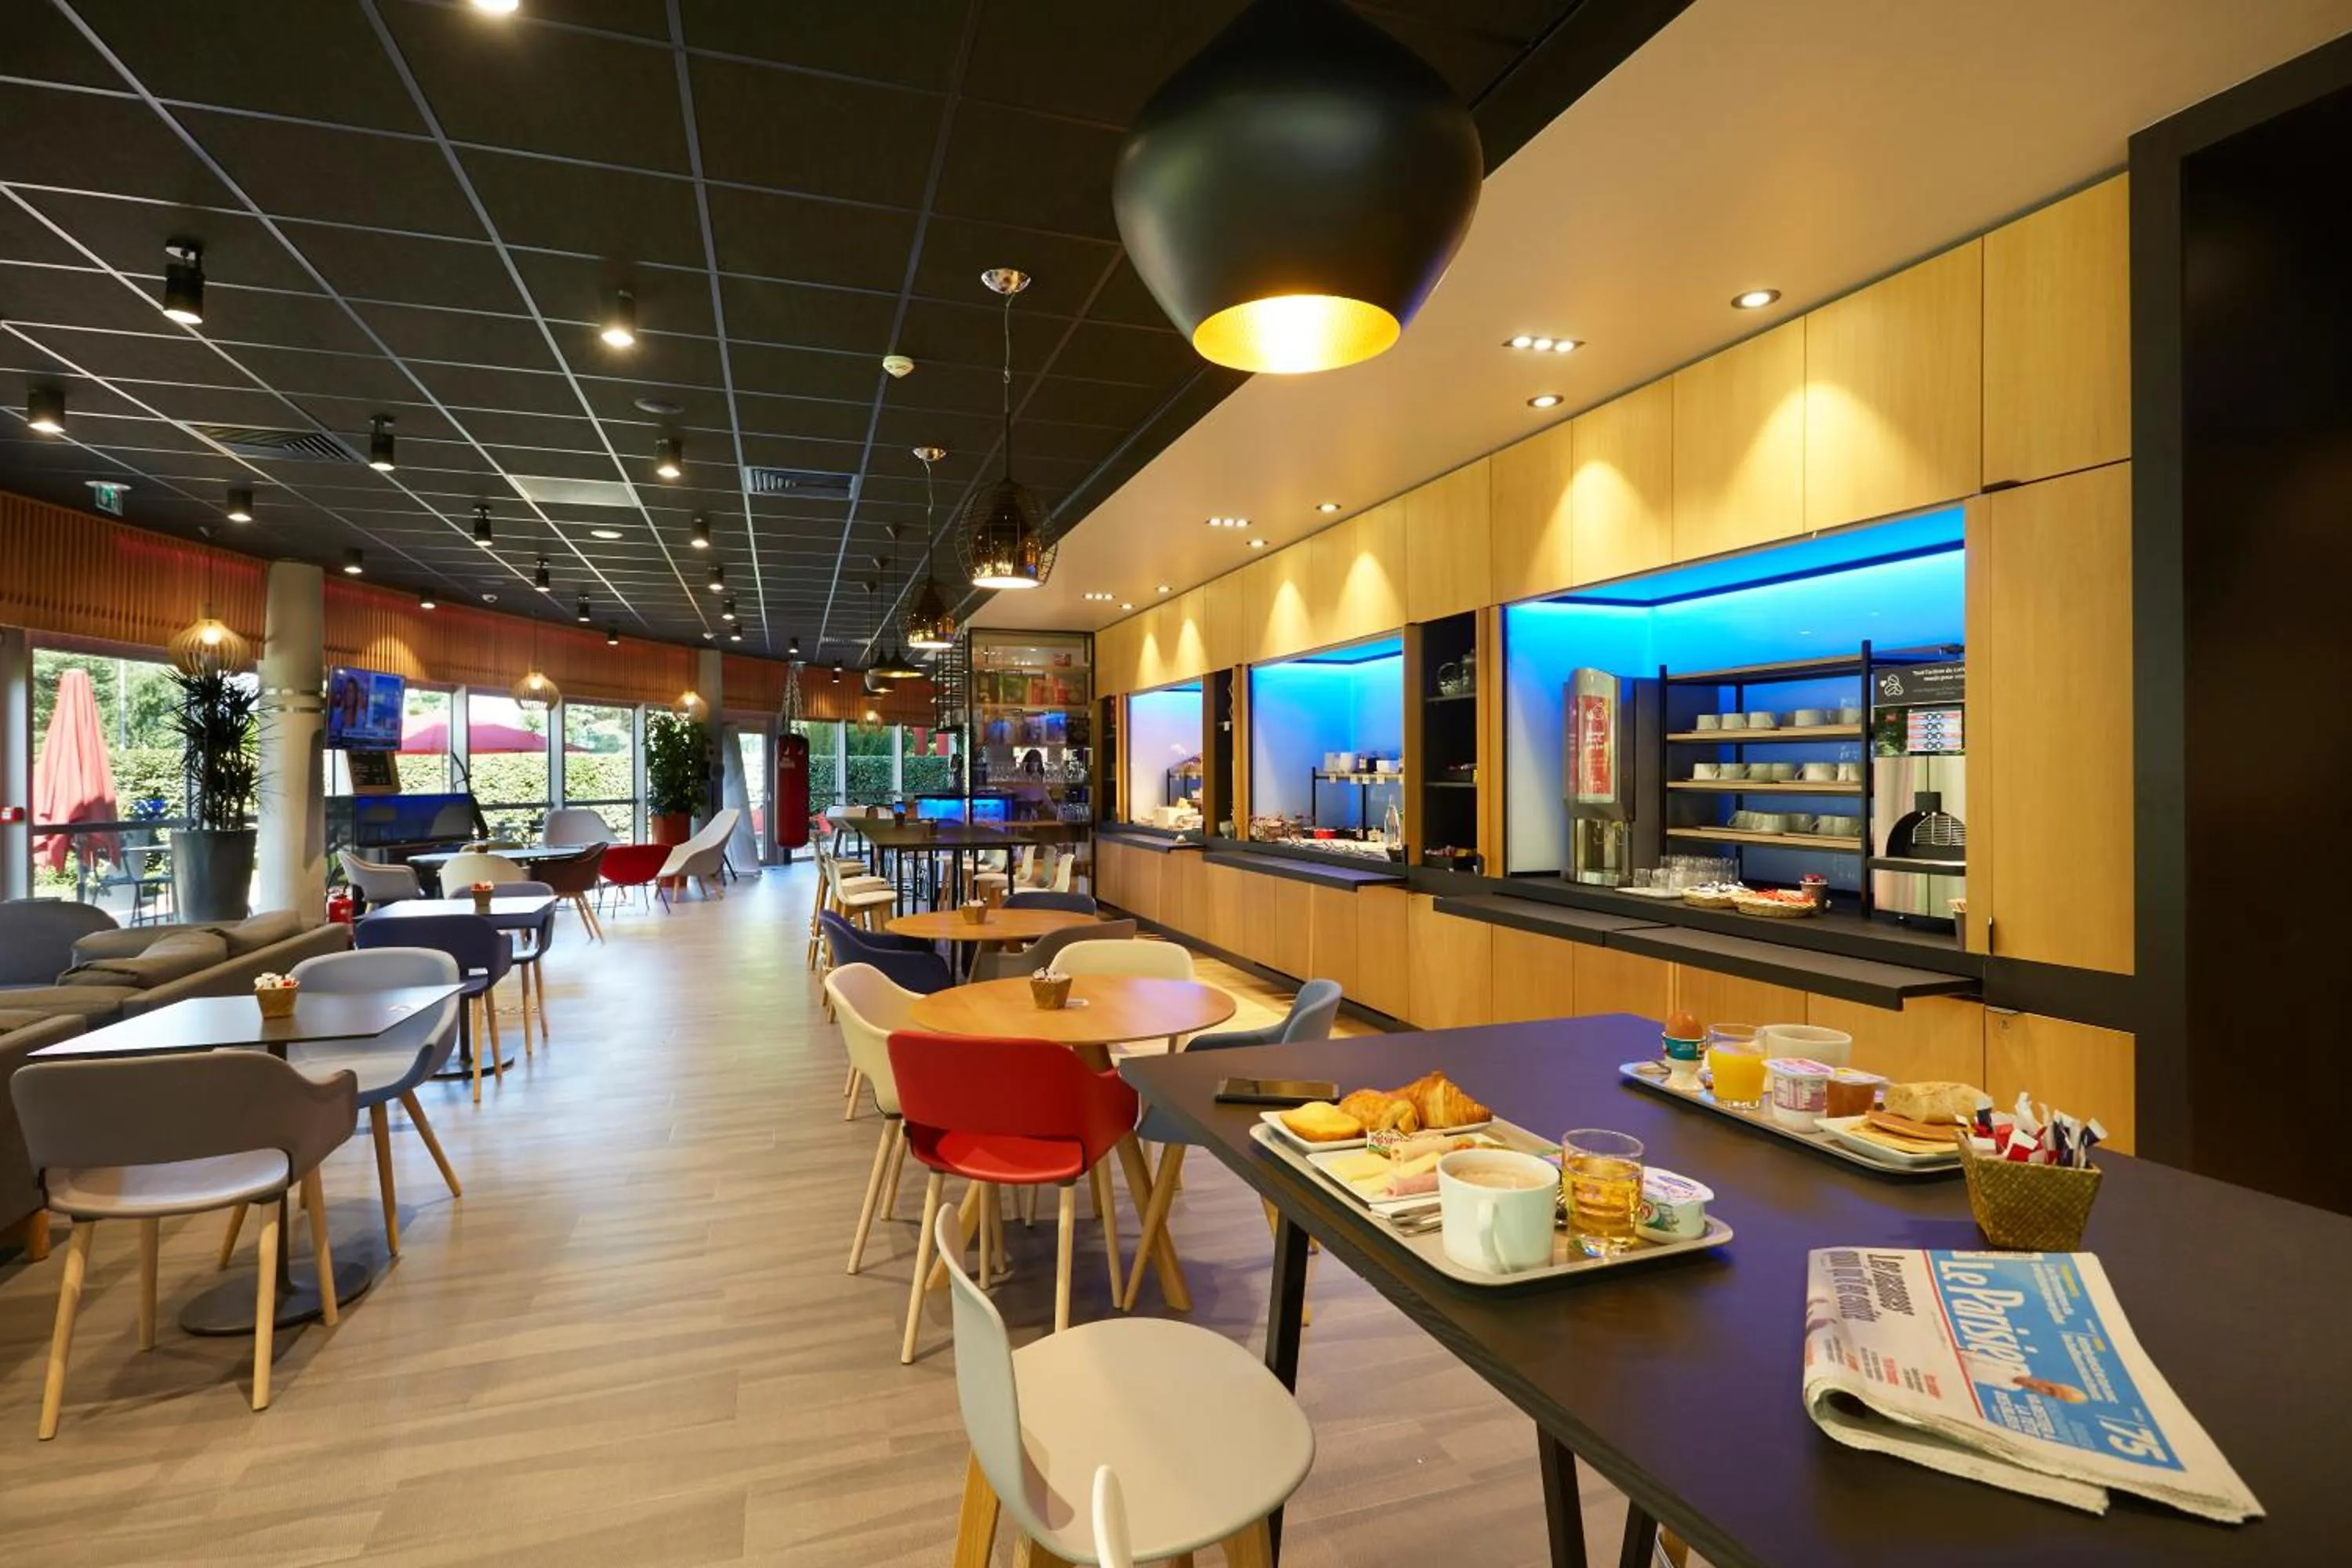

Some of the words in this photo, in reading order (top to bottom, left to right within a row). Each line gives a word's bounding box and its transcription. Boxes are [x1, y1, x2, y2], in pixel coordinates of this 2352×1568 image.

[1867, 1254, 1904, 1273] Les
[1939, 1261, 1996, 1286] Le
[2099, 1418, 2169, 1463] 75
